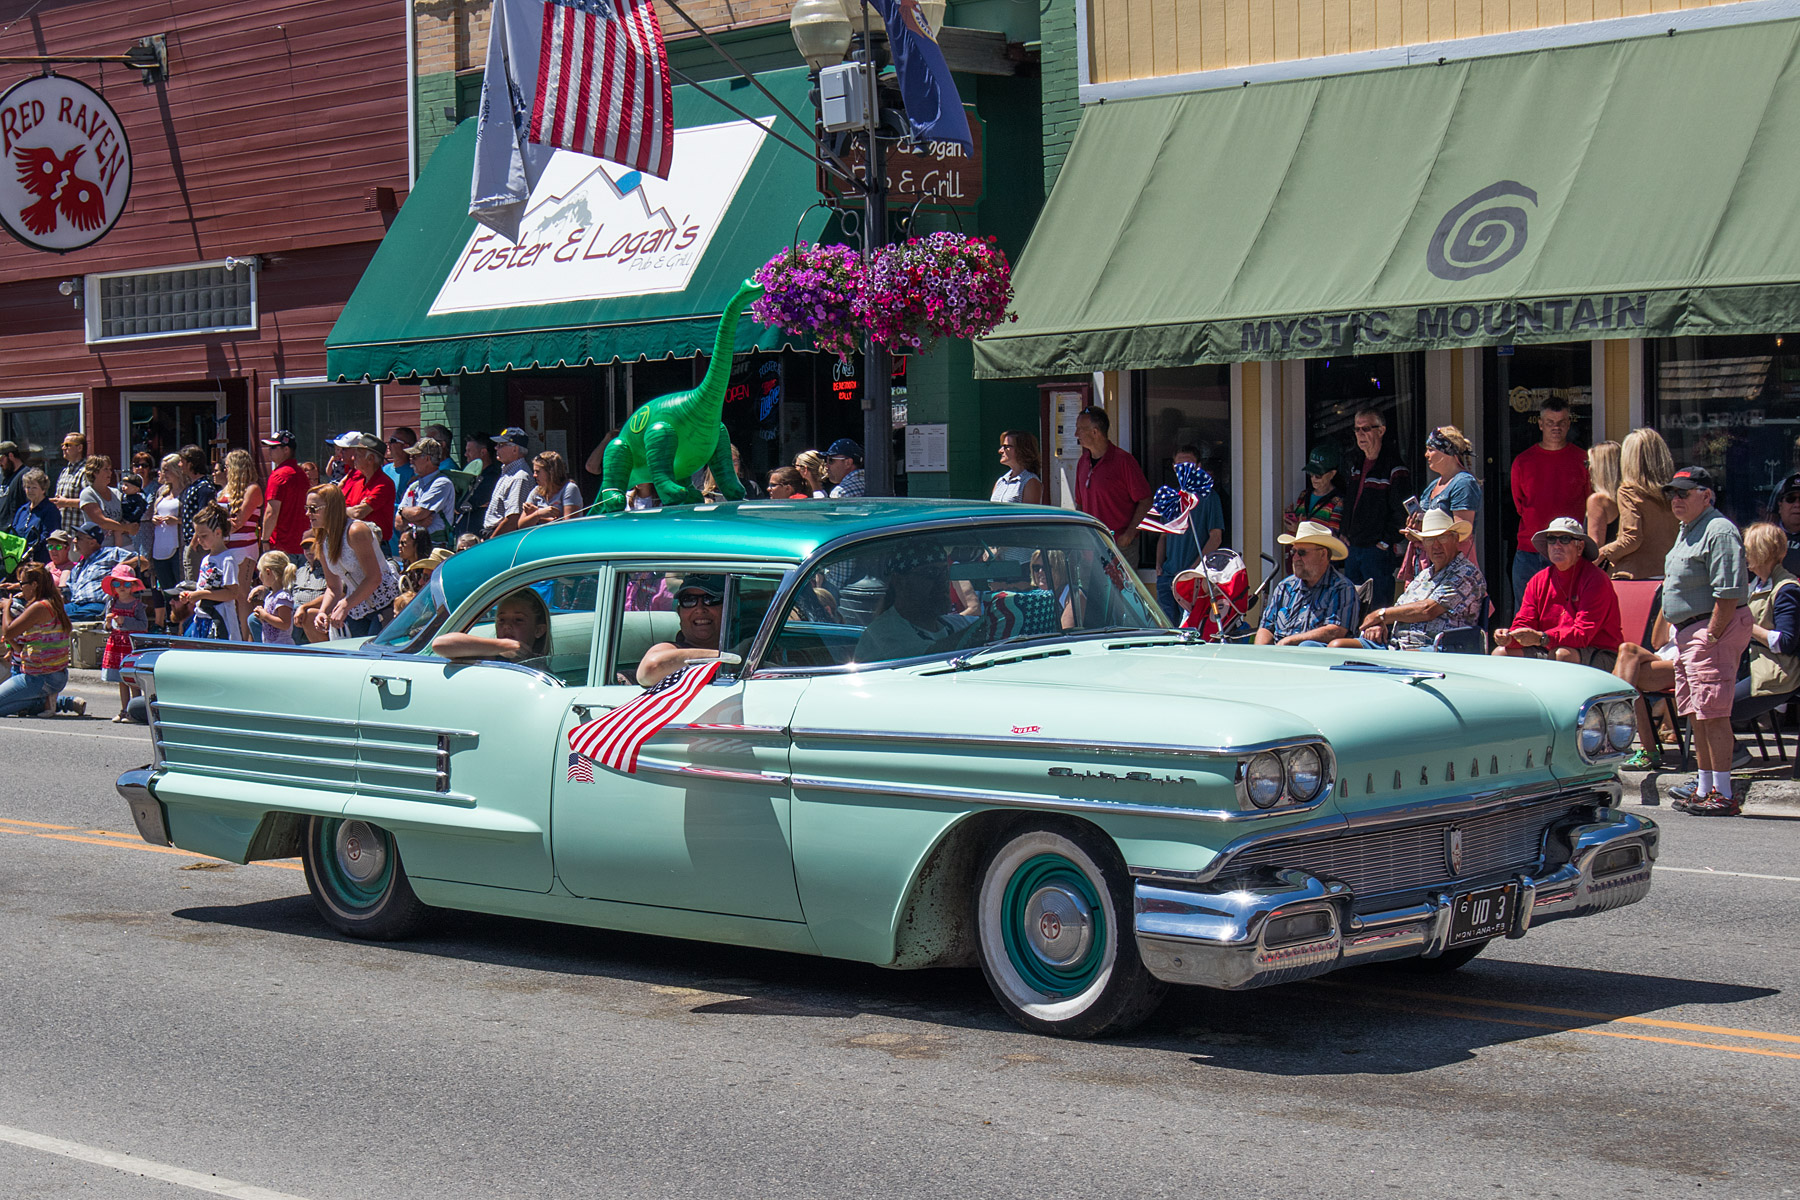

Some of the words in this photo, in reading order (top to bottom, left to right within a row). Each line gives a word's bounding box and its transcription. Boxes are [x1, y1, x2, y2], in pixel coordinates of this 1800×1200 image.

[1, 99, 45, 158] RED
[58, 97, 125, 196] RAVEN
[921, 169, 965, 204] Grill
[453, 231, 552, 282] Foster
[554, 227, 585, 263] &
[582, 214, 701, 264] Logan's
[628, 256, 653, 272] Pub
[666, 251, 694, 271] Grill
[1240, 311, 1392, 352] MYSTIC
[1416, 295, 1648, 338] MOUNTAIN
[725, 383, 750, 404] OPEN
[1017, 726, 1033, 734] USA
[1461, 902, 1469, 913] 6
[1495, 895, 1506, 920] 3
